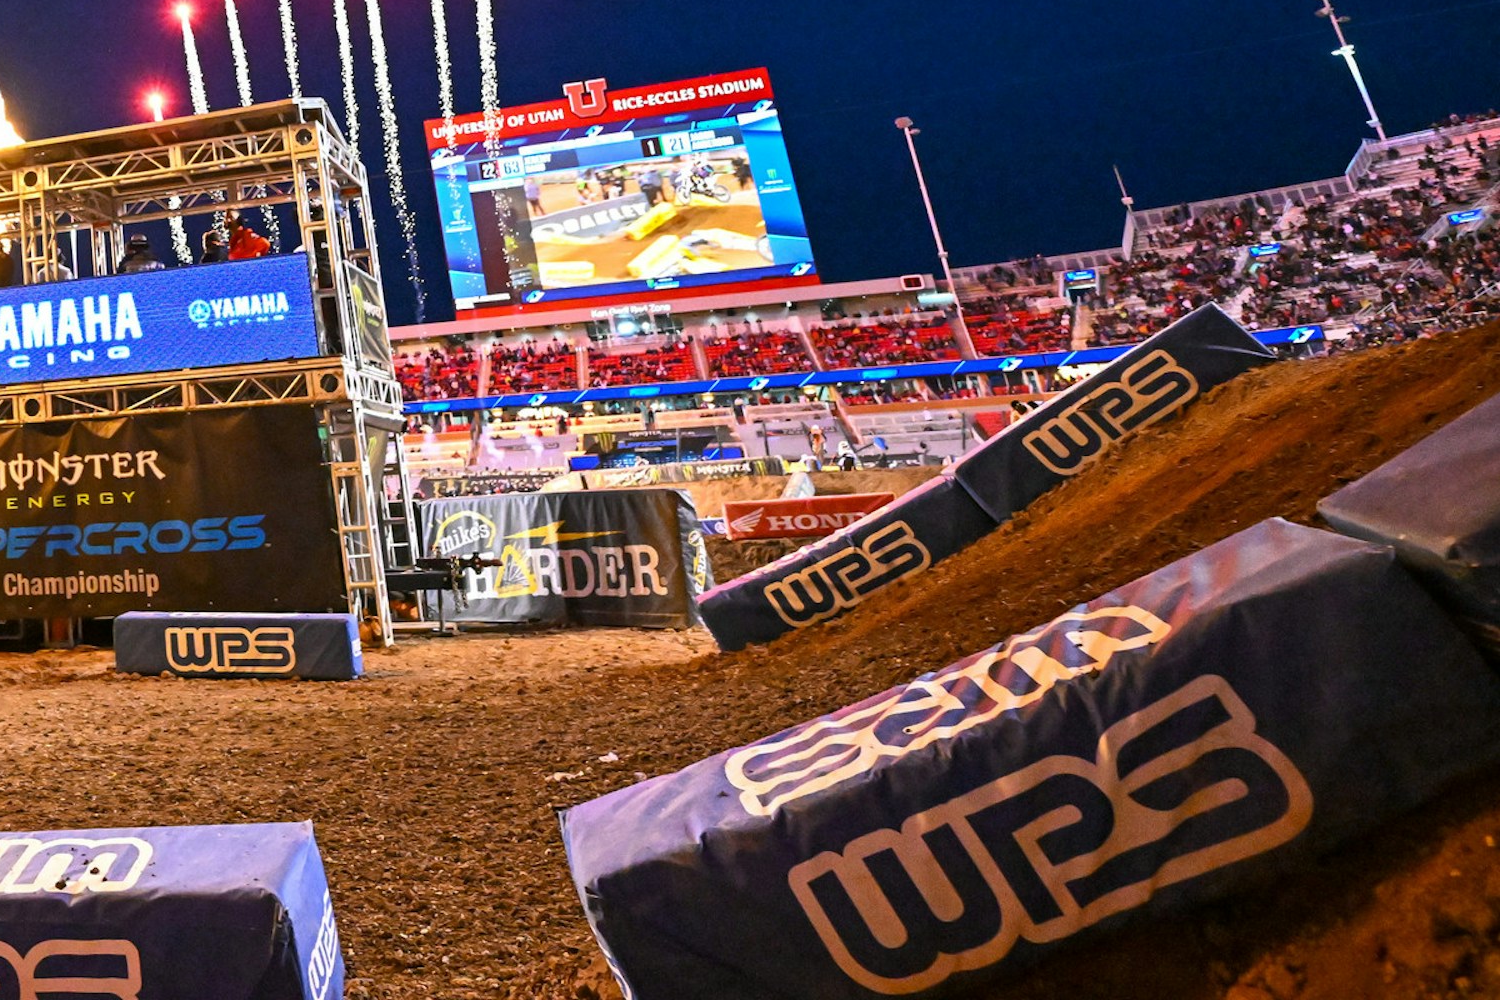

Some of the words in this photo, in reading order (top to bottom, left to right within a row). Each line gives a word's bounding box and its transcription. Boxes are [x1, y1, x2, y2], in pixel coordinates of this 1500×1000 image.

[612, 88, 696, 112] RICE-ECCLES
[698, 77, 764, 99] STADIUM
[507, 114, 525, 128] OF
[527, 108, 565, 125] UTAH
[646, 139, 655, 155] 1
[669, 138, 685, 152] 21
[210, 292, 289, 319] YAMAHA
[1022, 348, 1199, 477] WPS
[6, 491, 136, 510] ENERGY
[438, 519, 490, 556] mike's
[3, 568, 160, 599] Championship
[763, 520, 932, 627] WPS
[165, 627, 295, 673] WPS
[788, 674, 1314, 995] WPS
